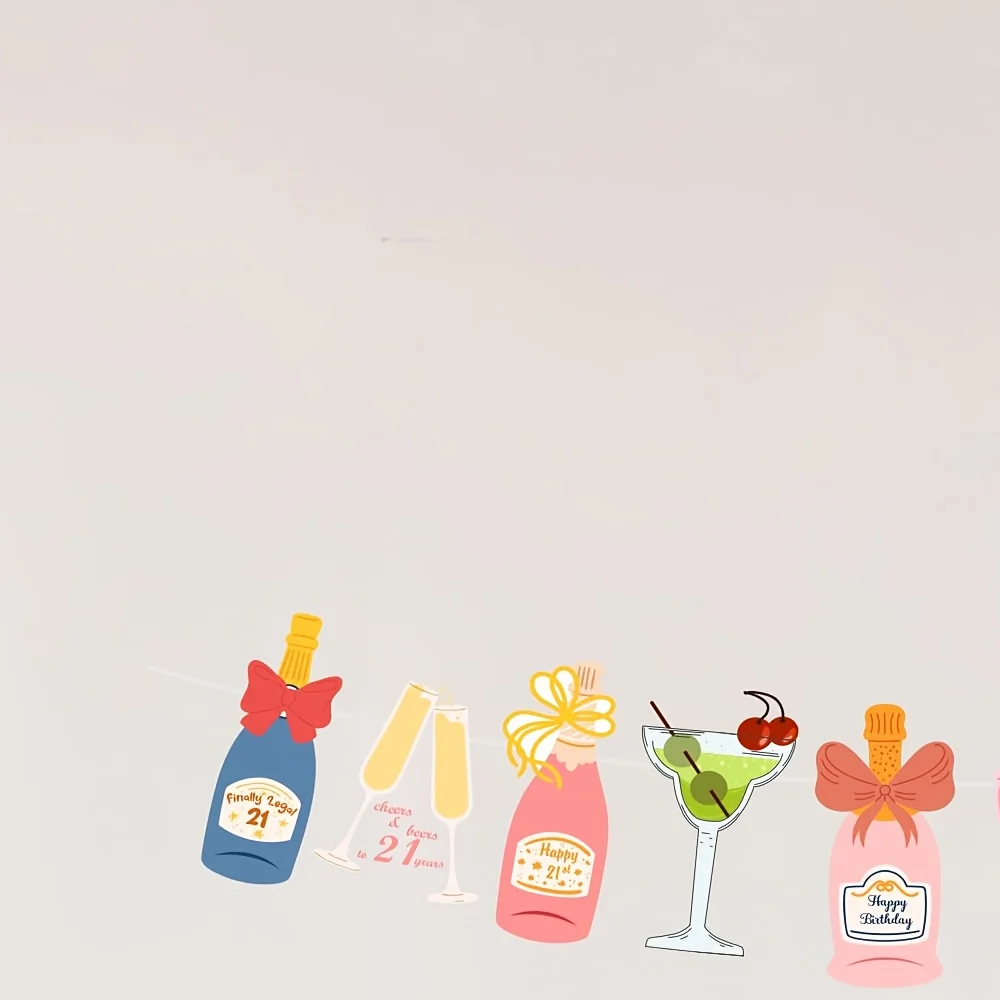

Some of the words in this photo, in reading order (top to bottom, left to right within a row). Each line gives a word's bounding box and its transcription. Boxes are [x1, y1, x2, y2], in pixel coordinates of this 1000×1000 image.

[227, 792, 262, 805] Finally
[373, 800, 413, 816] cheers
[246, 807, 269, 828] 21
[388, 816, 401, 828] &
[406, 824, 438, 840] beers
[357, 849, 367, 859] to
[373, 835, 421, 866] 21
[413, 858, 444, 868] years
[540, 842, 579, 864] Happy
[546, 864, 571, 880] 21st
[867, 894, 907, 913] Happy
[859, 912, 914, 931] Birthday
